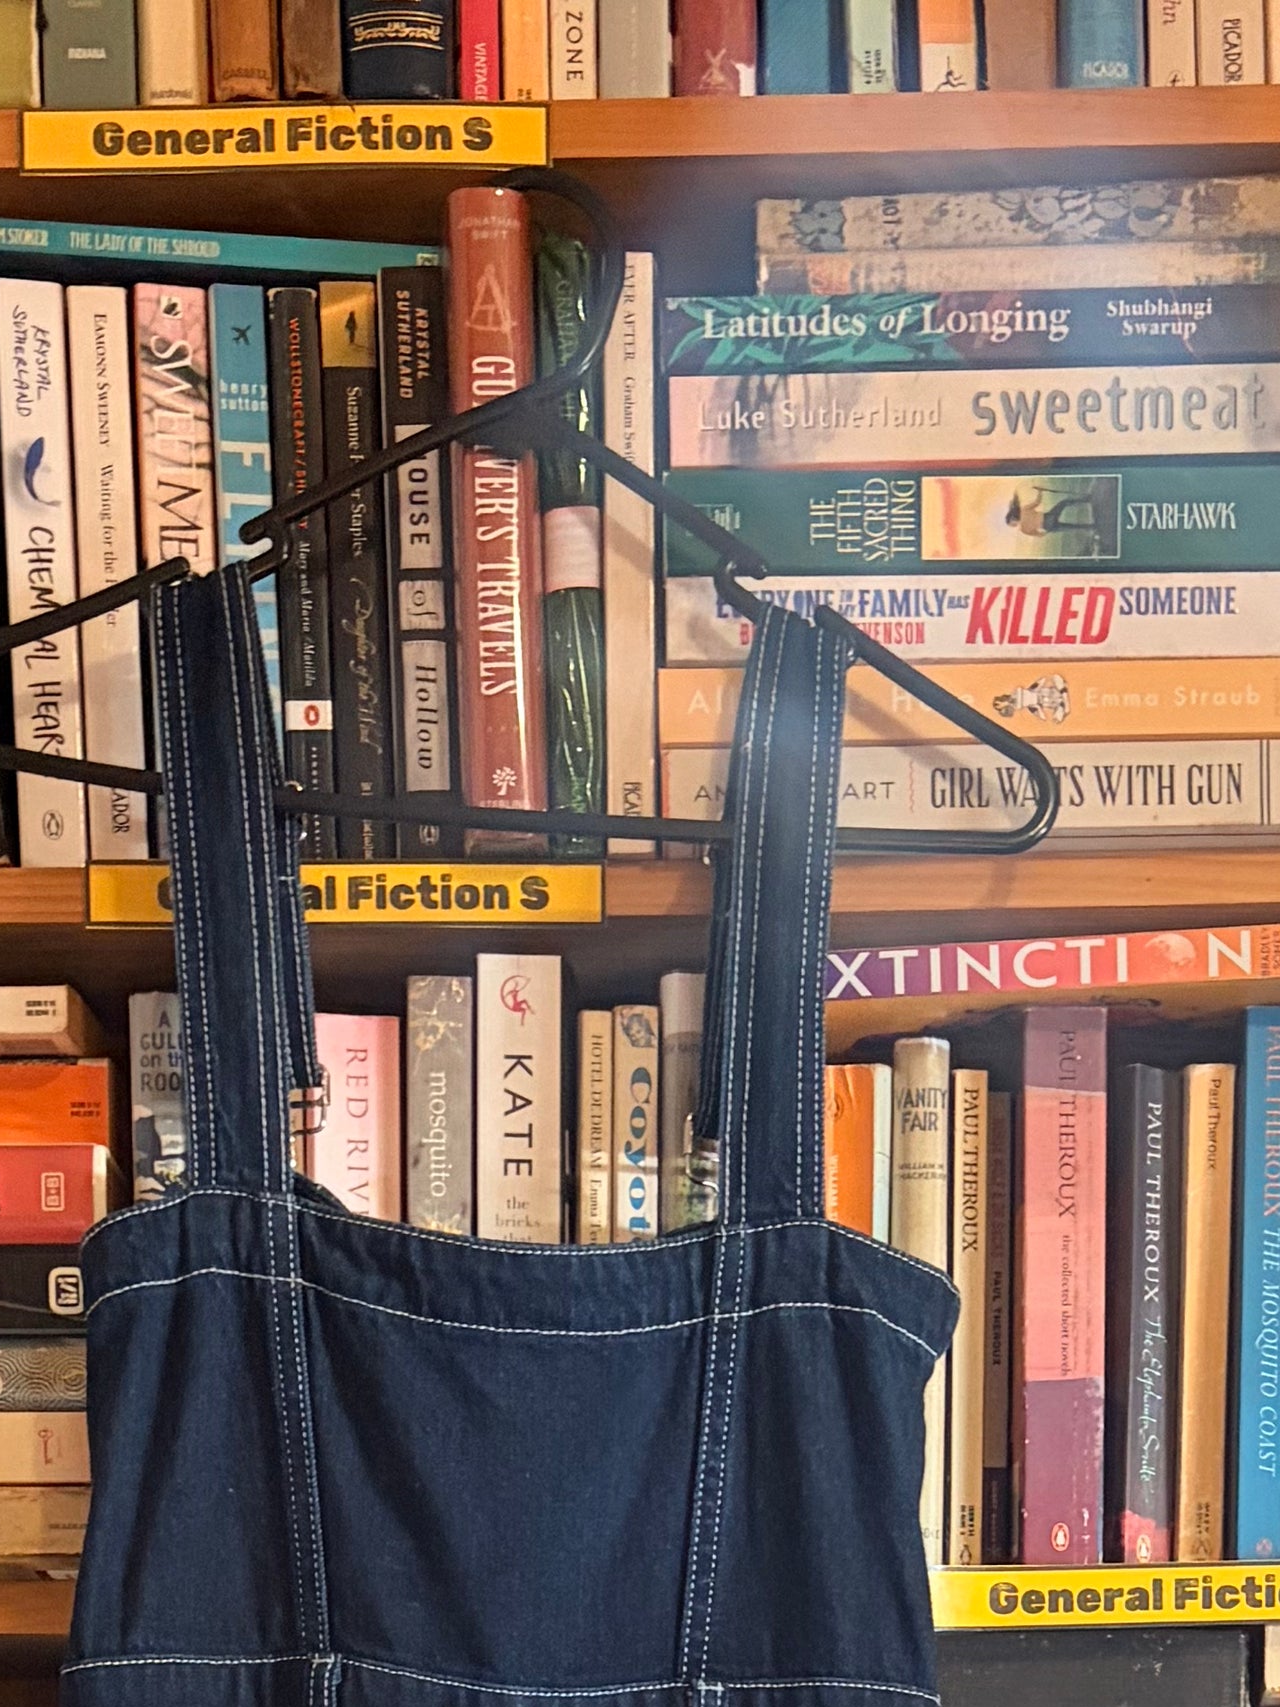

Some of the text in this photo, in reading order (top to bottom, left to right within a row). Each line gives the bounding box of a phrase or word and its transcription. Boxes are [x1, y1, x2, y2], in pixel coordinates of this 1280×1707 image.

[565, 10, 583, 82] ZONE
[93, 115, 493, 157] General Fiction S
[704, 304, 1070, 342] Latitudes of Longing
[972, 374, 1266, 437] sweetmeat
[1127, 503, 1236, 530] STARHAWK
[966, 586, 1238, 646] KILLED SOMEONE
[347, 873, 550, 911] Fiction S
[425, 1071, 449, 1199] mosquito
[503, 1054, 534, 1179] KATE
[989, 1580, 1164, 1615] General
